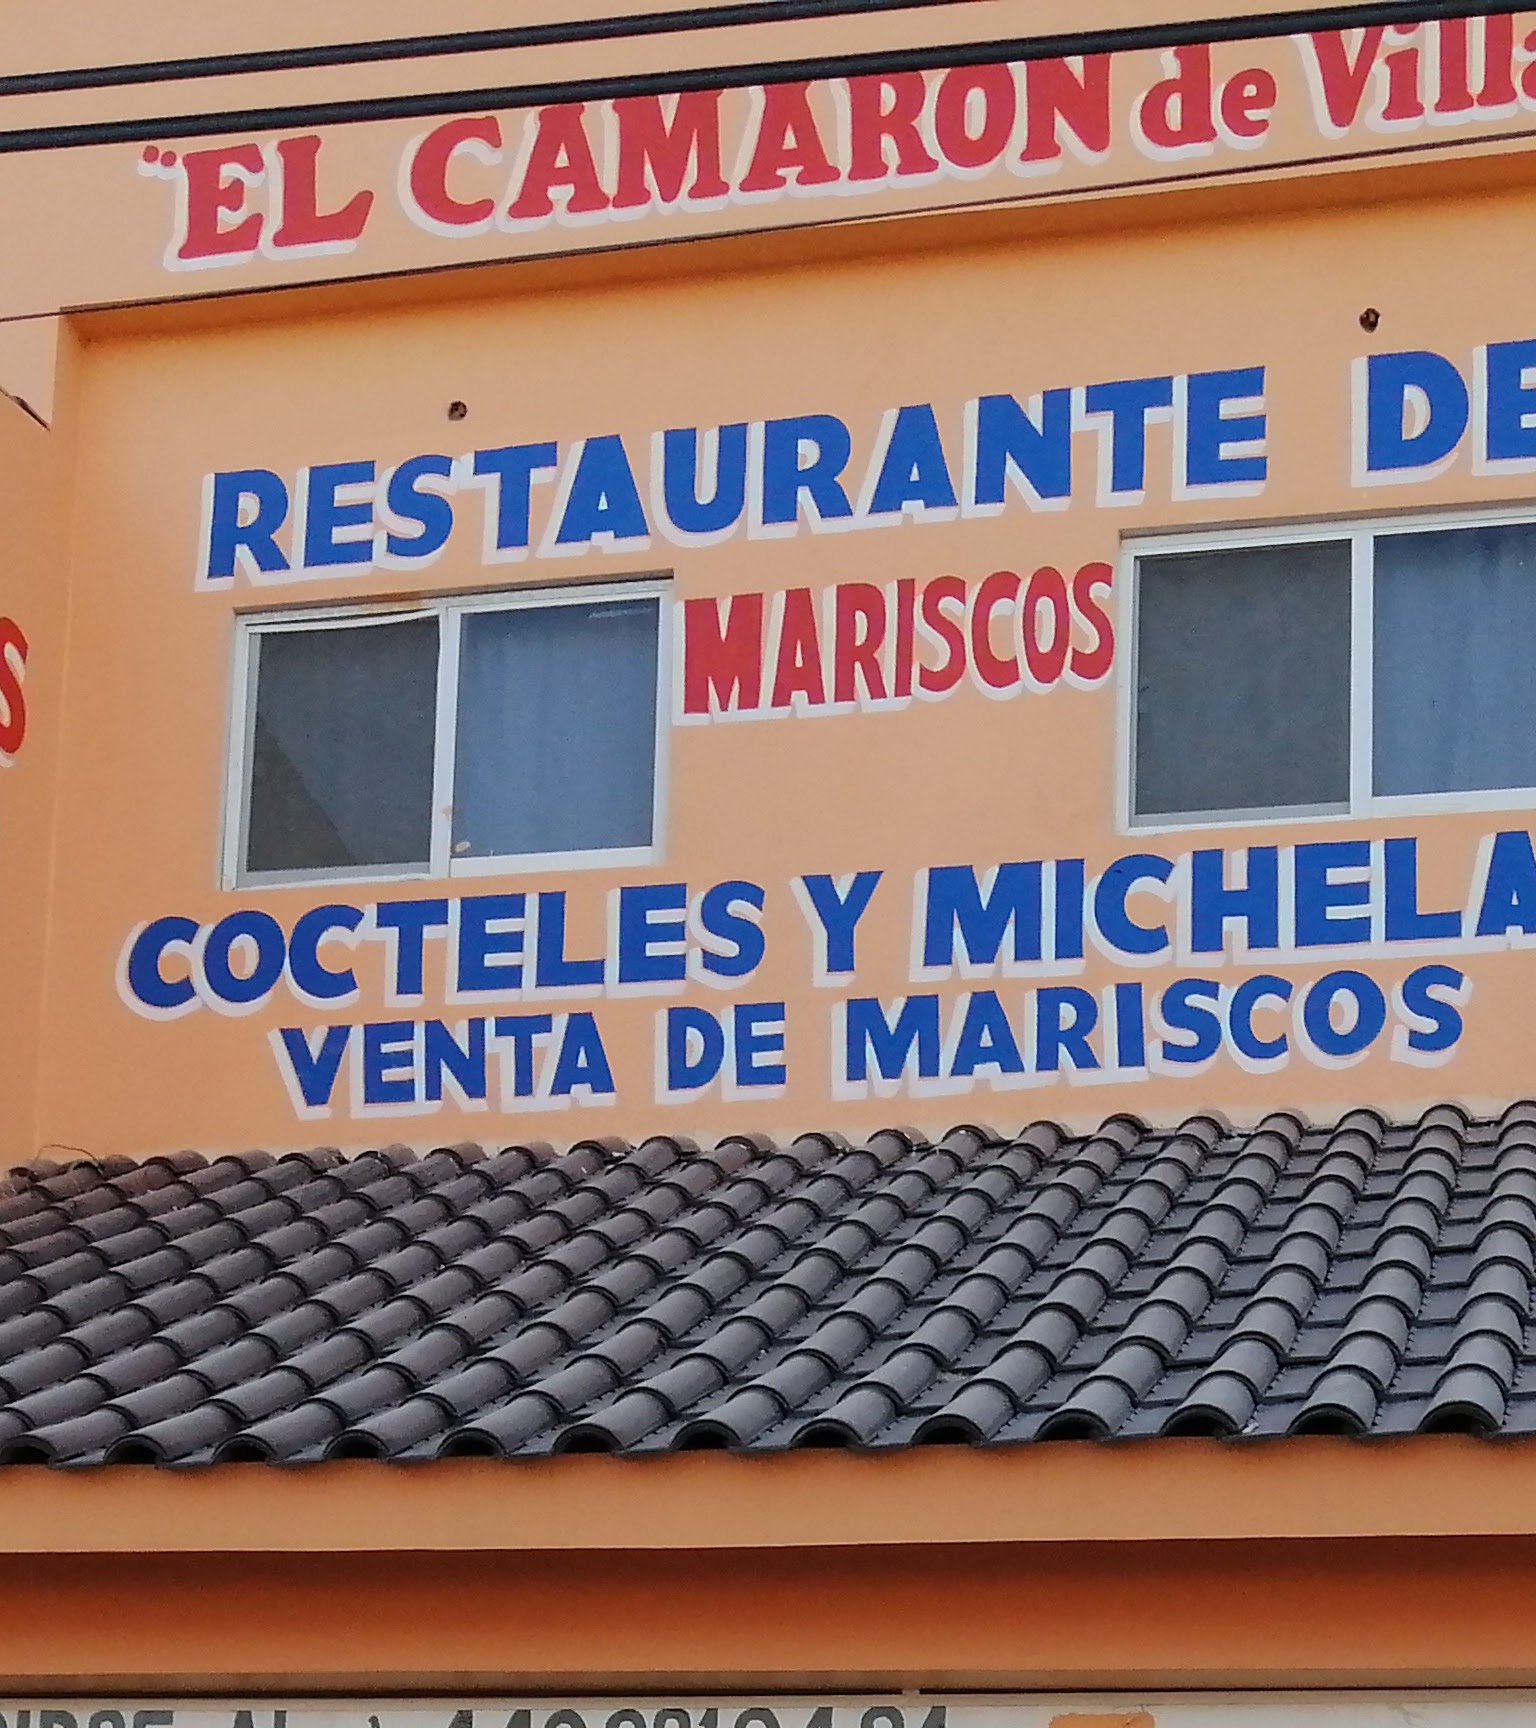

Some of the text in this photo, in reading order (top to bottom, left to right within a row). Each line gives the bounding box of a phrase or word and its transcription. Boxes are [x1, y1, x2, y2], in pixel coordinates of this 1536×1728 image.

[409, 52, 1114, 226] CAMARON
[1139, 43, 1278, 148] de
[206, 365, 1268, 580] RESTAURANTE
[683, 561, 1116, 714] MARISCOS
[126, 880, 766, 1010] COCTELES
[802, 871, 884, 973] Y
[279, 964, 1467, 1107] VENTA DE MARISCOS
